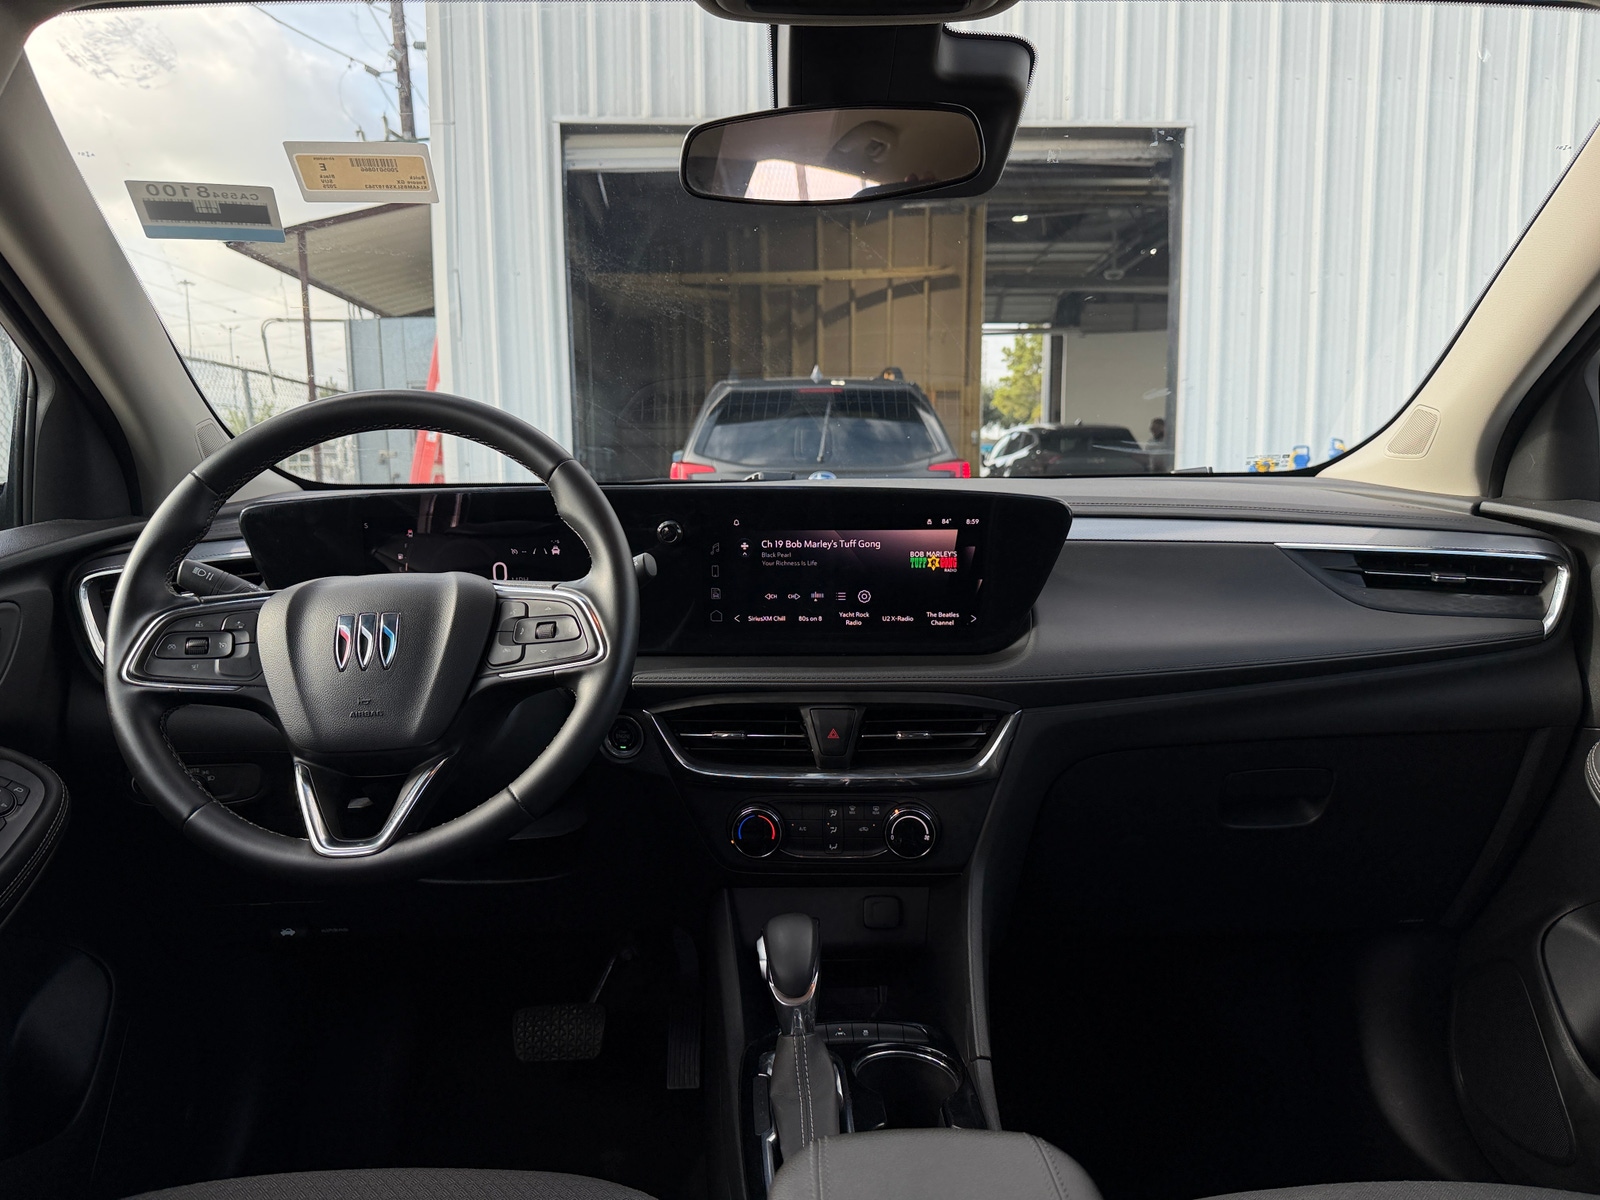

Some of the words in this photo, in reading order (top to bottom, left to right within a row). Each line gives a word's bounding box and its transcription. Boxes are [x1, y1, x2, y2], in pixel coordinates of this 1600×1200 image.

[761, 540, 773, 548] Ch
[774, 540, 784, 548] 19
[785, 540, 802, 548] Bob
[803, 539, 838, 550] Marley's
[839, 539, 857, 548] Tuff
[858, 539, 881, 550] Gong
[926, 550, 958, 558] MARLEY'S
[909, 557, 927, 569] TUFF
